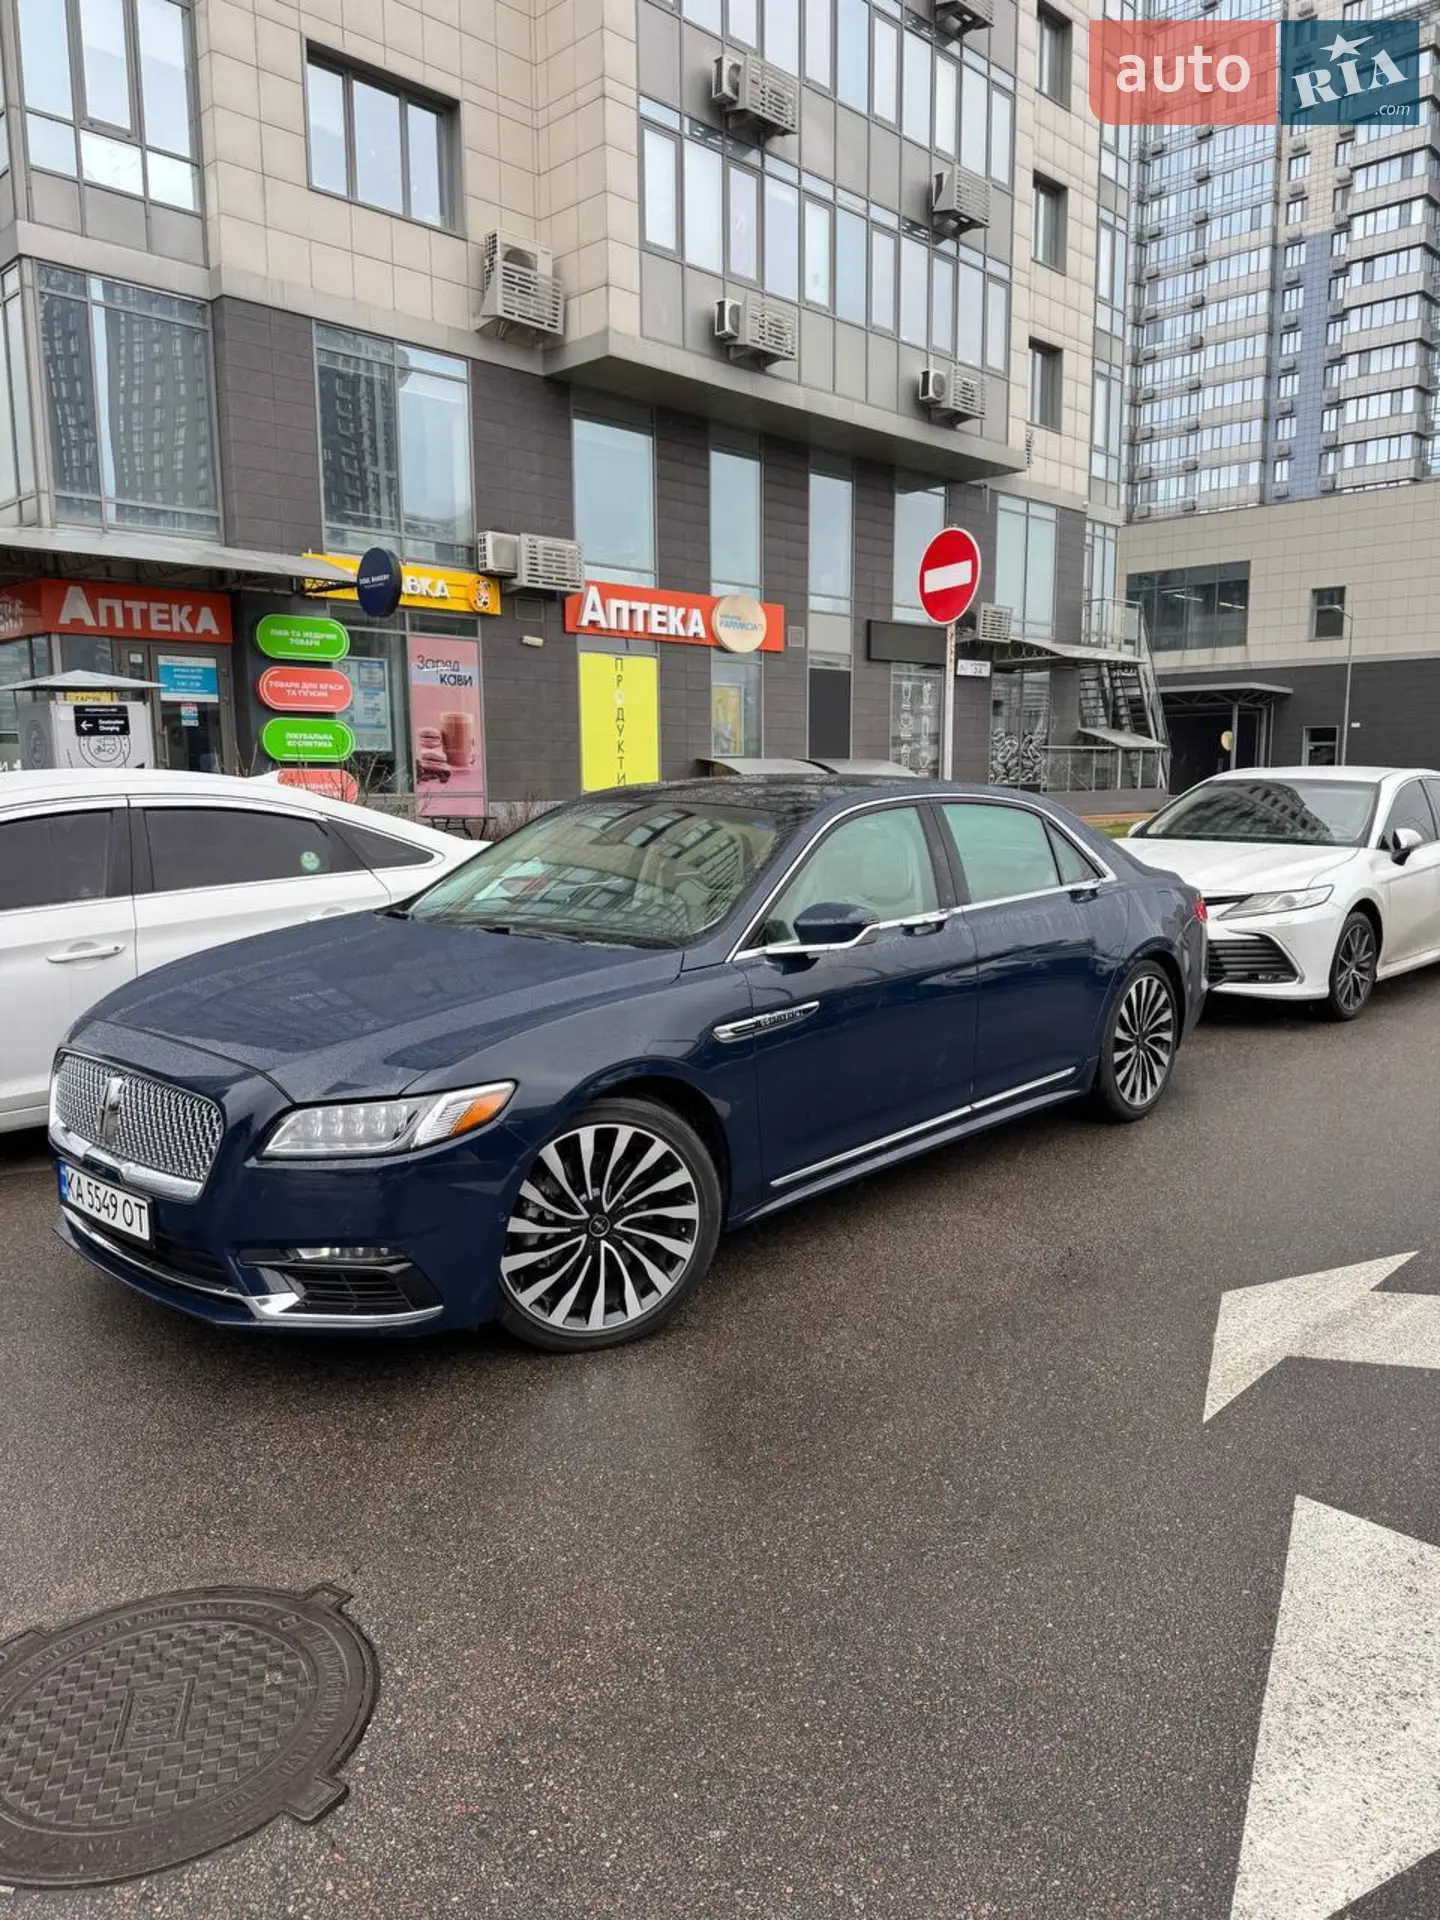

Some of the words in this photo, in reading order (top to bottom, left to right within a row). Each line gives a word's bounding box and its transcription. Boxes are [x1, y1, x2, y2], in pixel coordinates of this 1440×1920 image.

[68, 1172, 86, 1204] KA
[87, 1182, 118, 1221] 5549
[122, 1199, 146, 1233] OT
